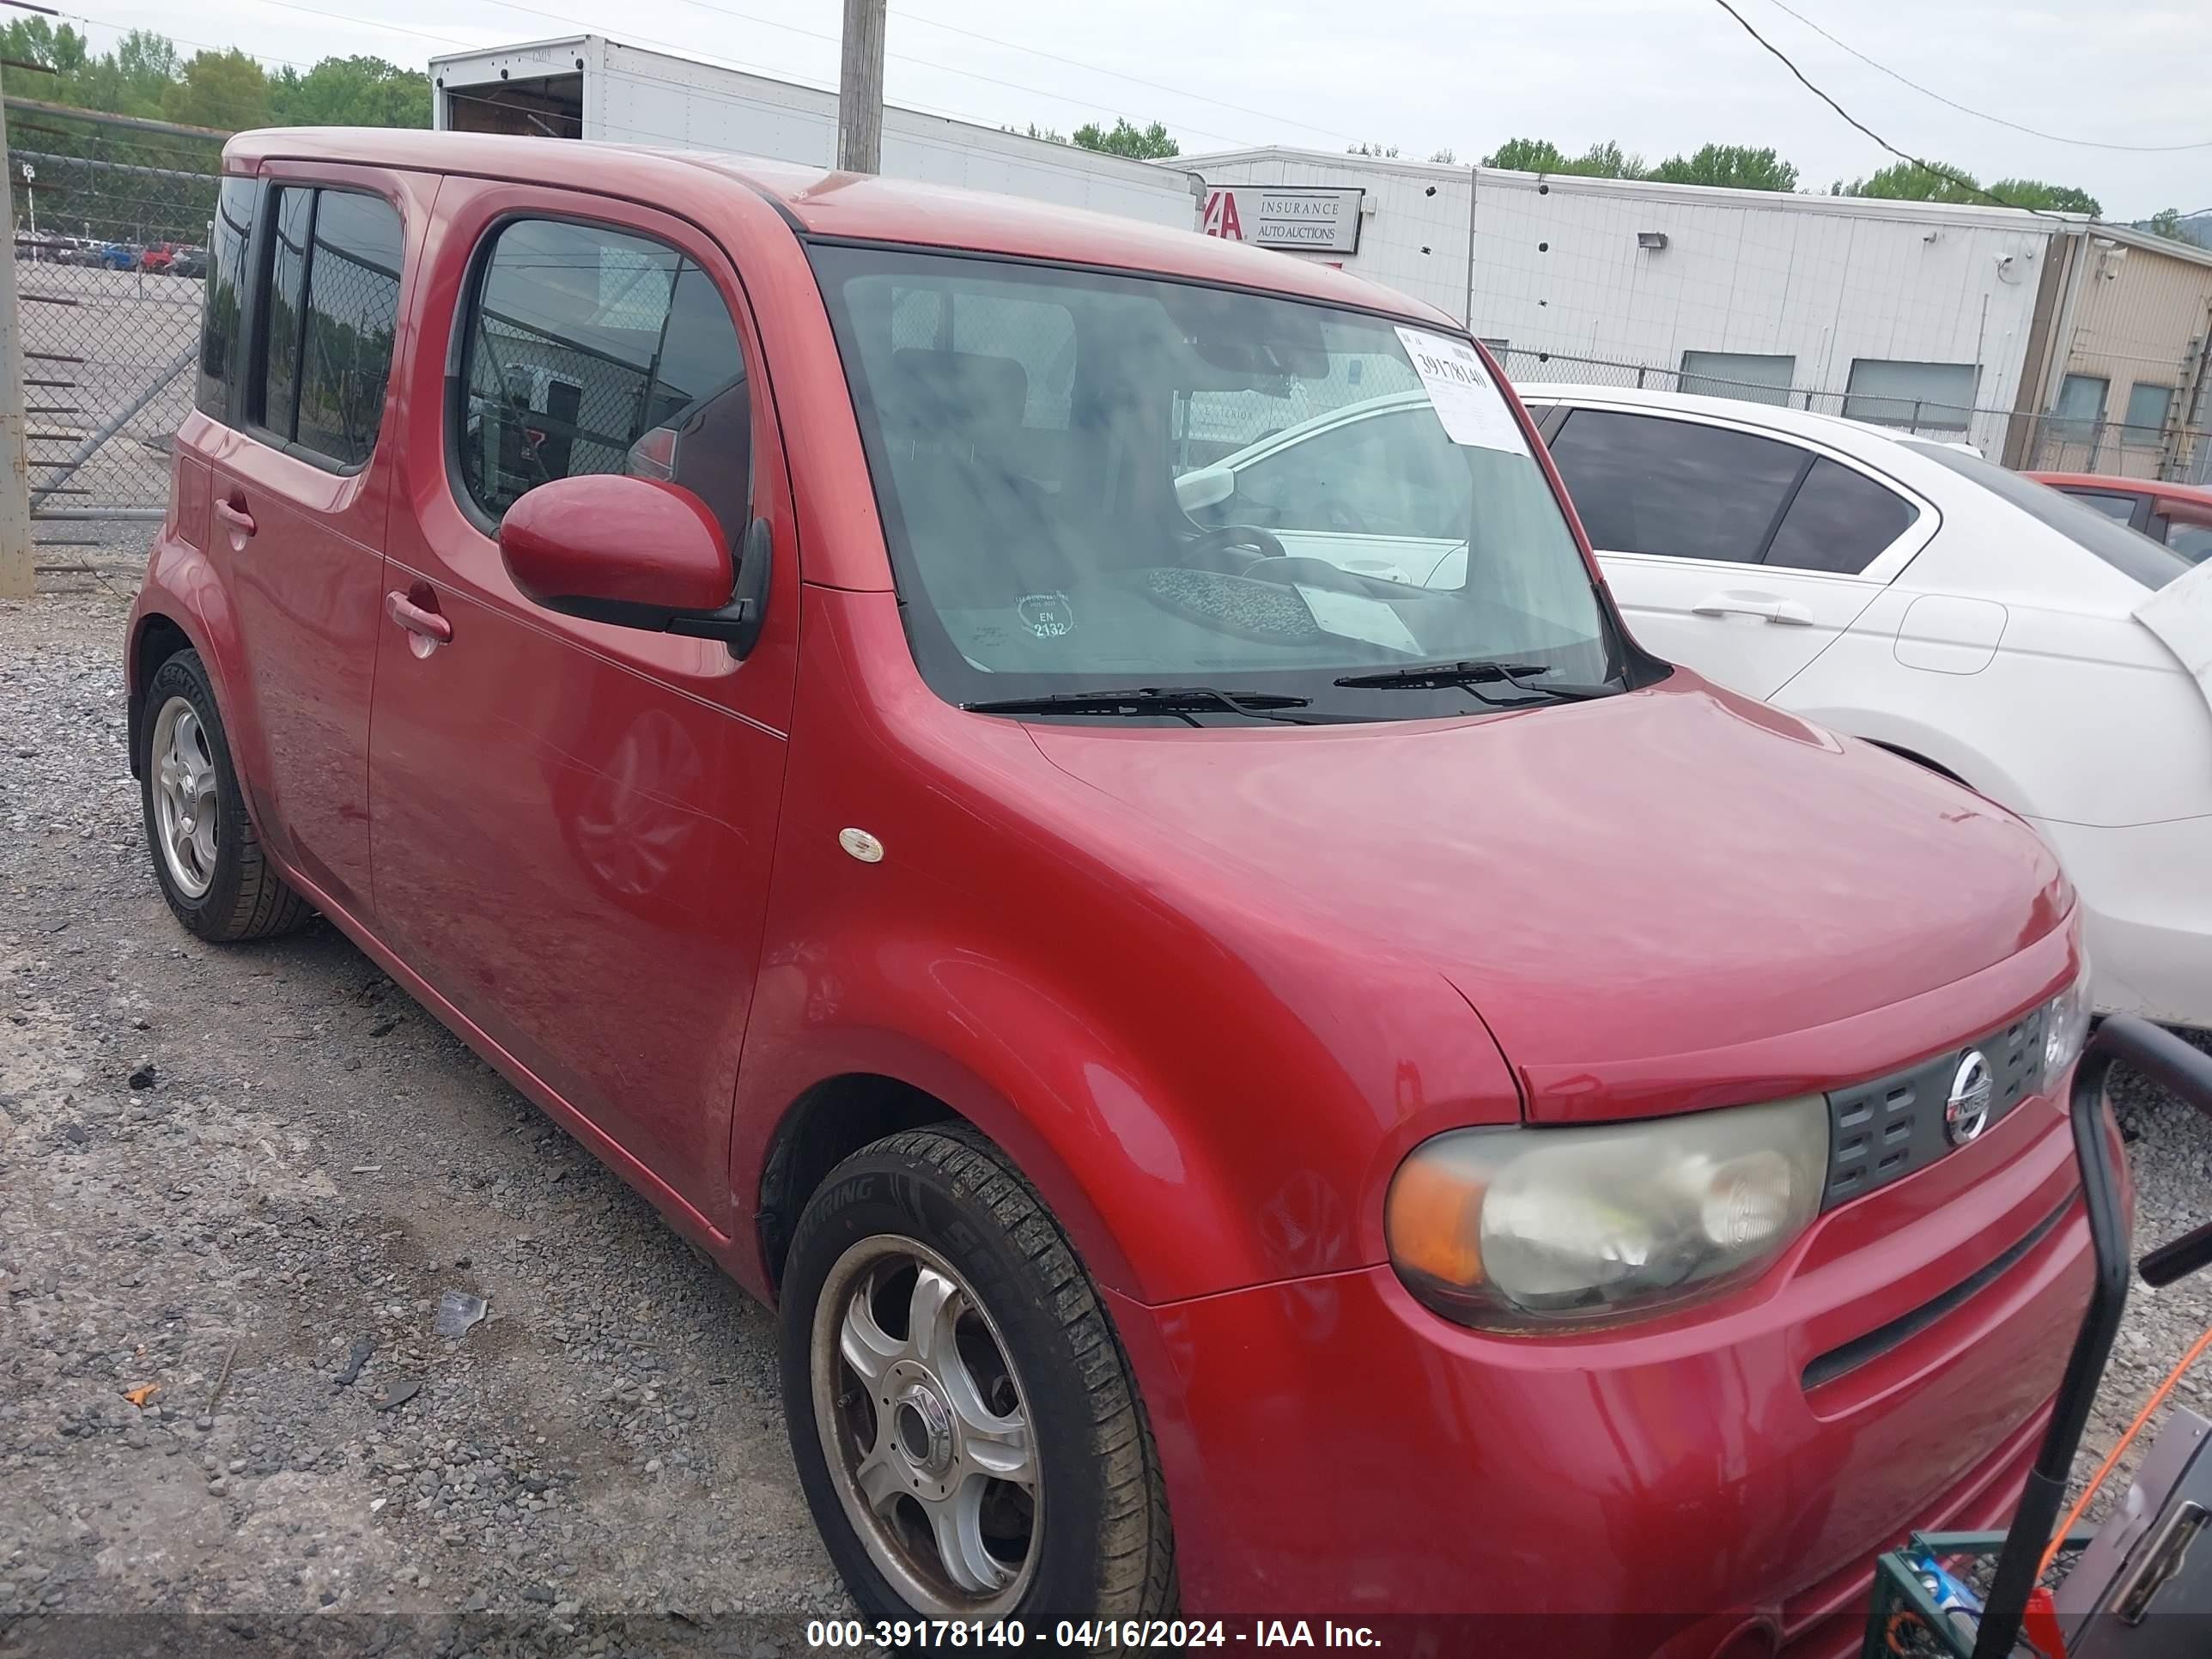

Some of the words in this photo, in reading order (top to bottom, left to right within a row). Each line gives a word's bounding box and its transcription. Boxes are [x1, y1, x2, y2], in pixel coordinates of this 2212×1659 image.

[1261, 201, 1340, 216] INSURANCE
[1258, 226, 1285, 237] AUTO
[1285, 227, 1335, 240] AUCTIONS
[1418, 354, 1487, 388] 39178140
[1039, 612, 1054, 622] EN
[1034, 623, 1066, 636] 2132
